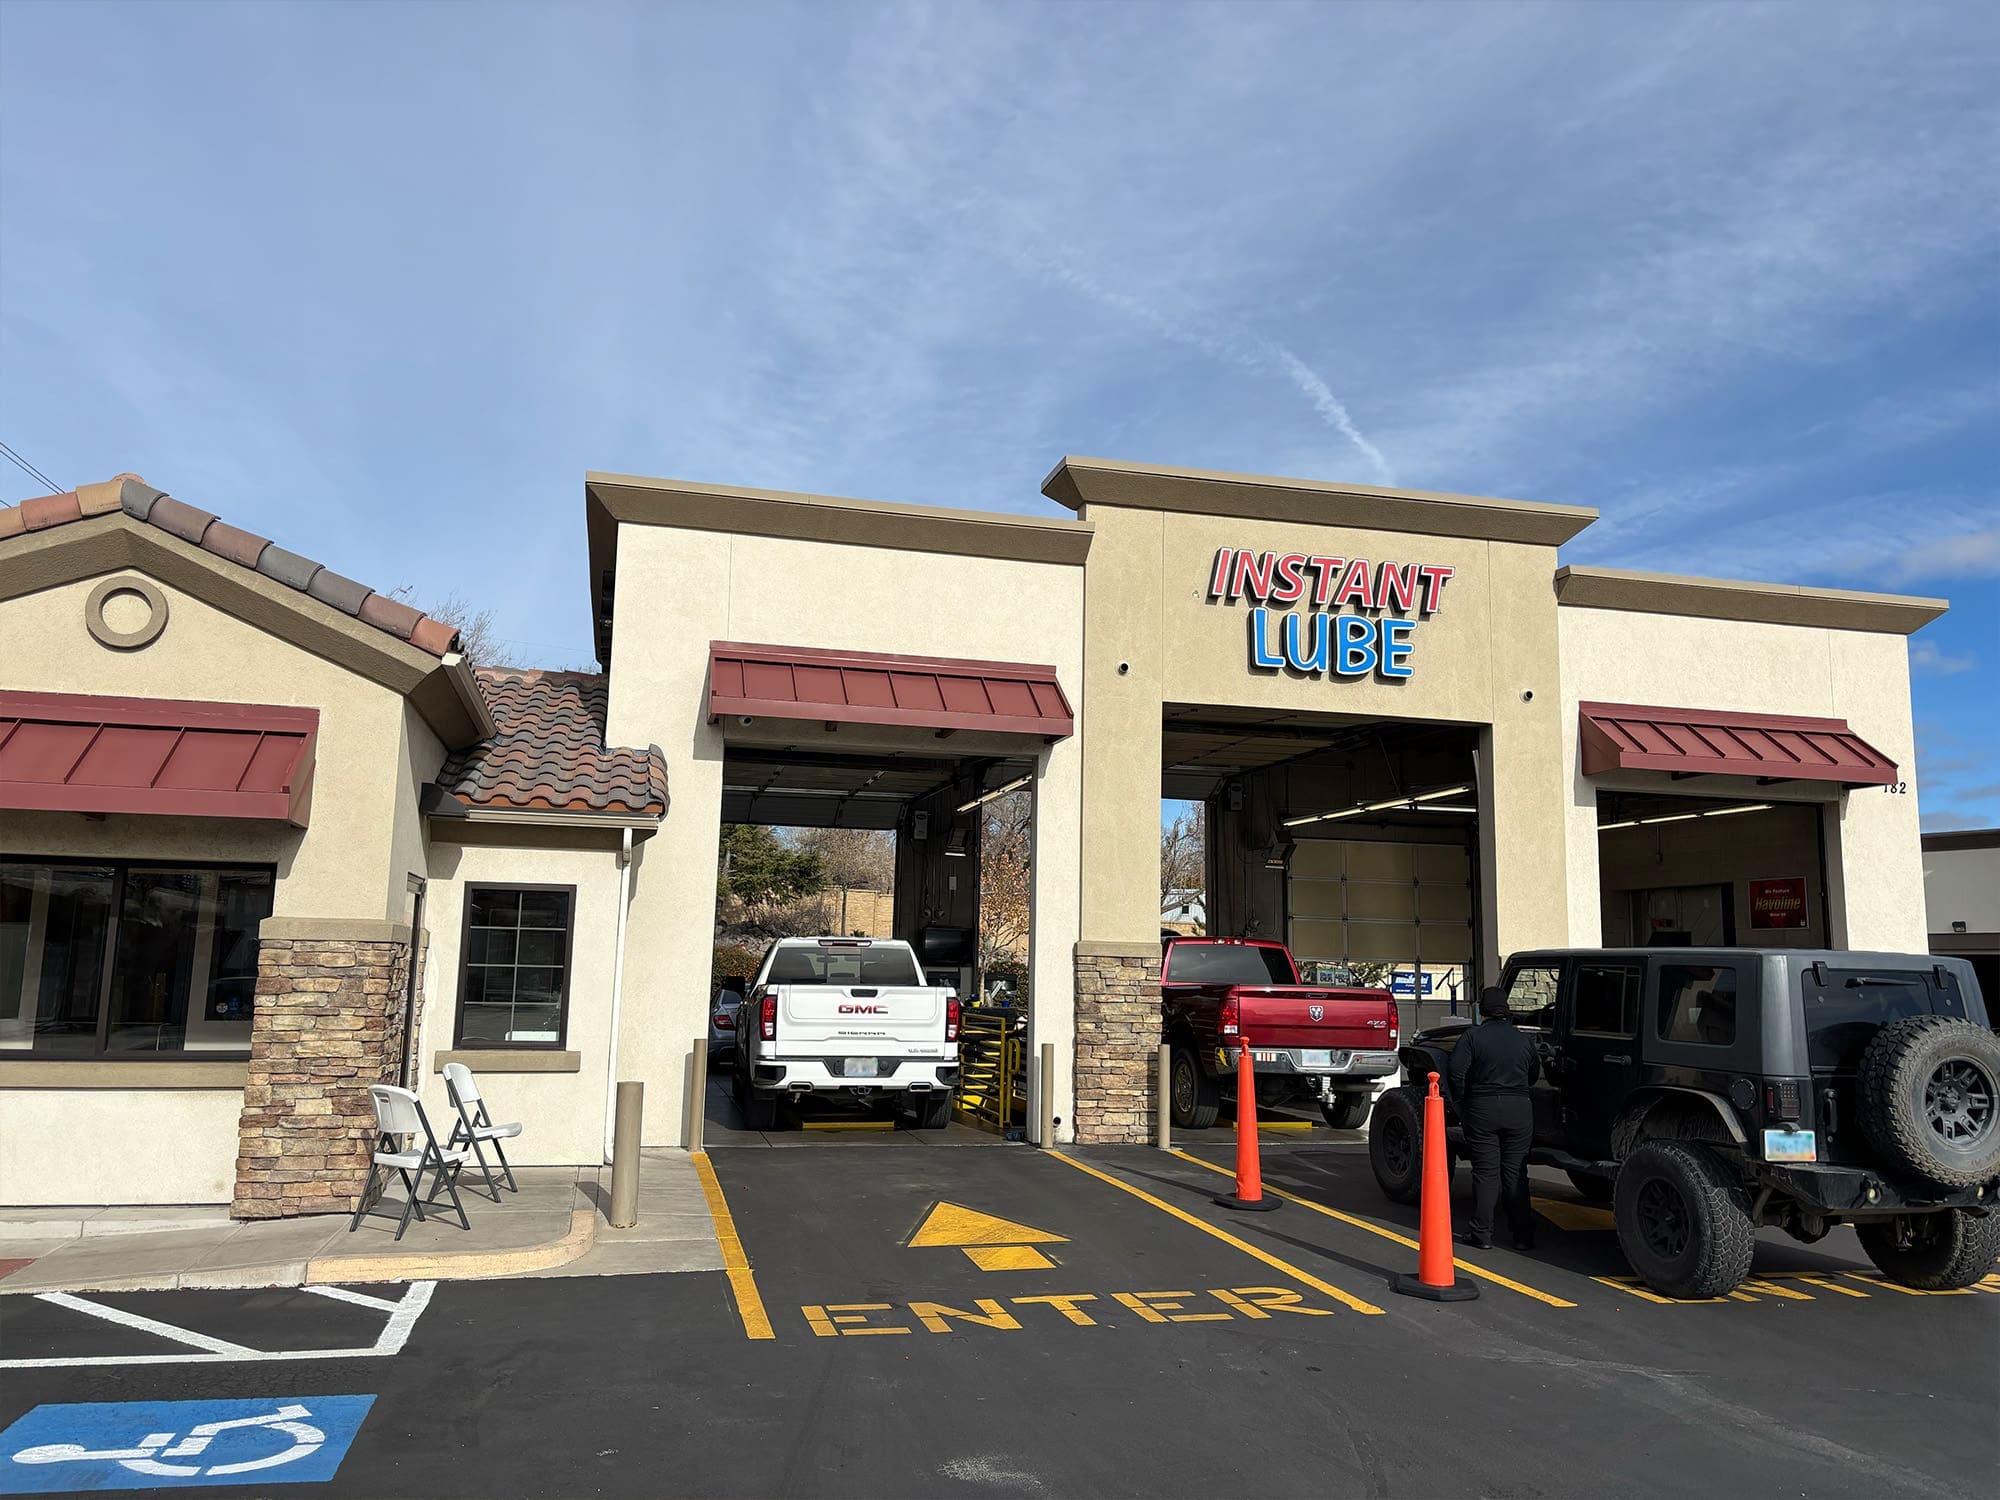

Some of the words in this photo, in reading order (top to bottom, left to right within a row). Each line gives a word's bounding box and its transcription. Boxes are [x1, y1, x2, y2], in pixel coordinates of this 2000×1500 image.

[1208, 546, 1455, 615] INSTANT
[1250, 606, 1418, 680] LUBE
[1755, 896, 1801, 911] Havoline
[838, 1004, 888, 1014] GMC
[801, 1286, 1335, 1337] ENTER
